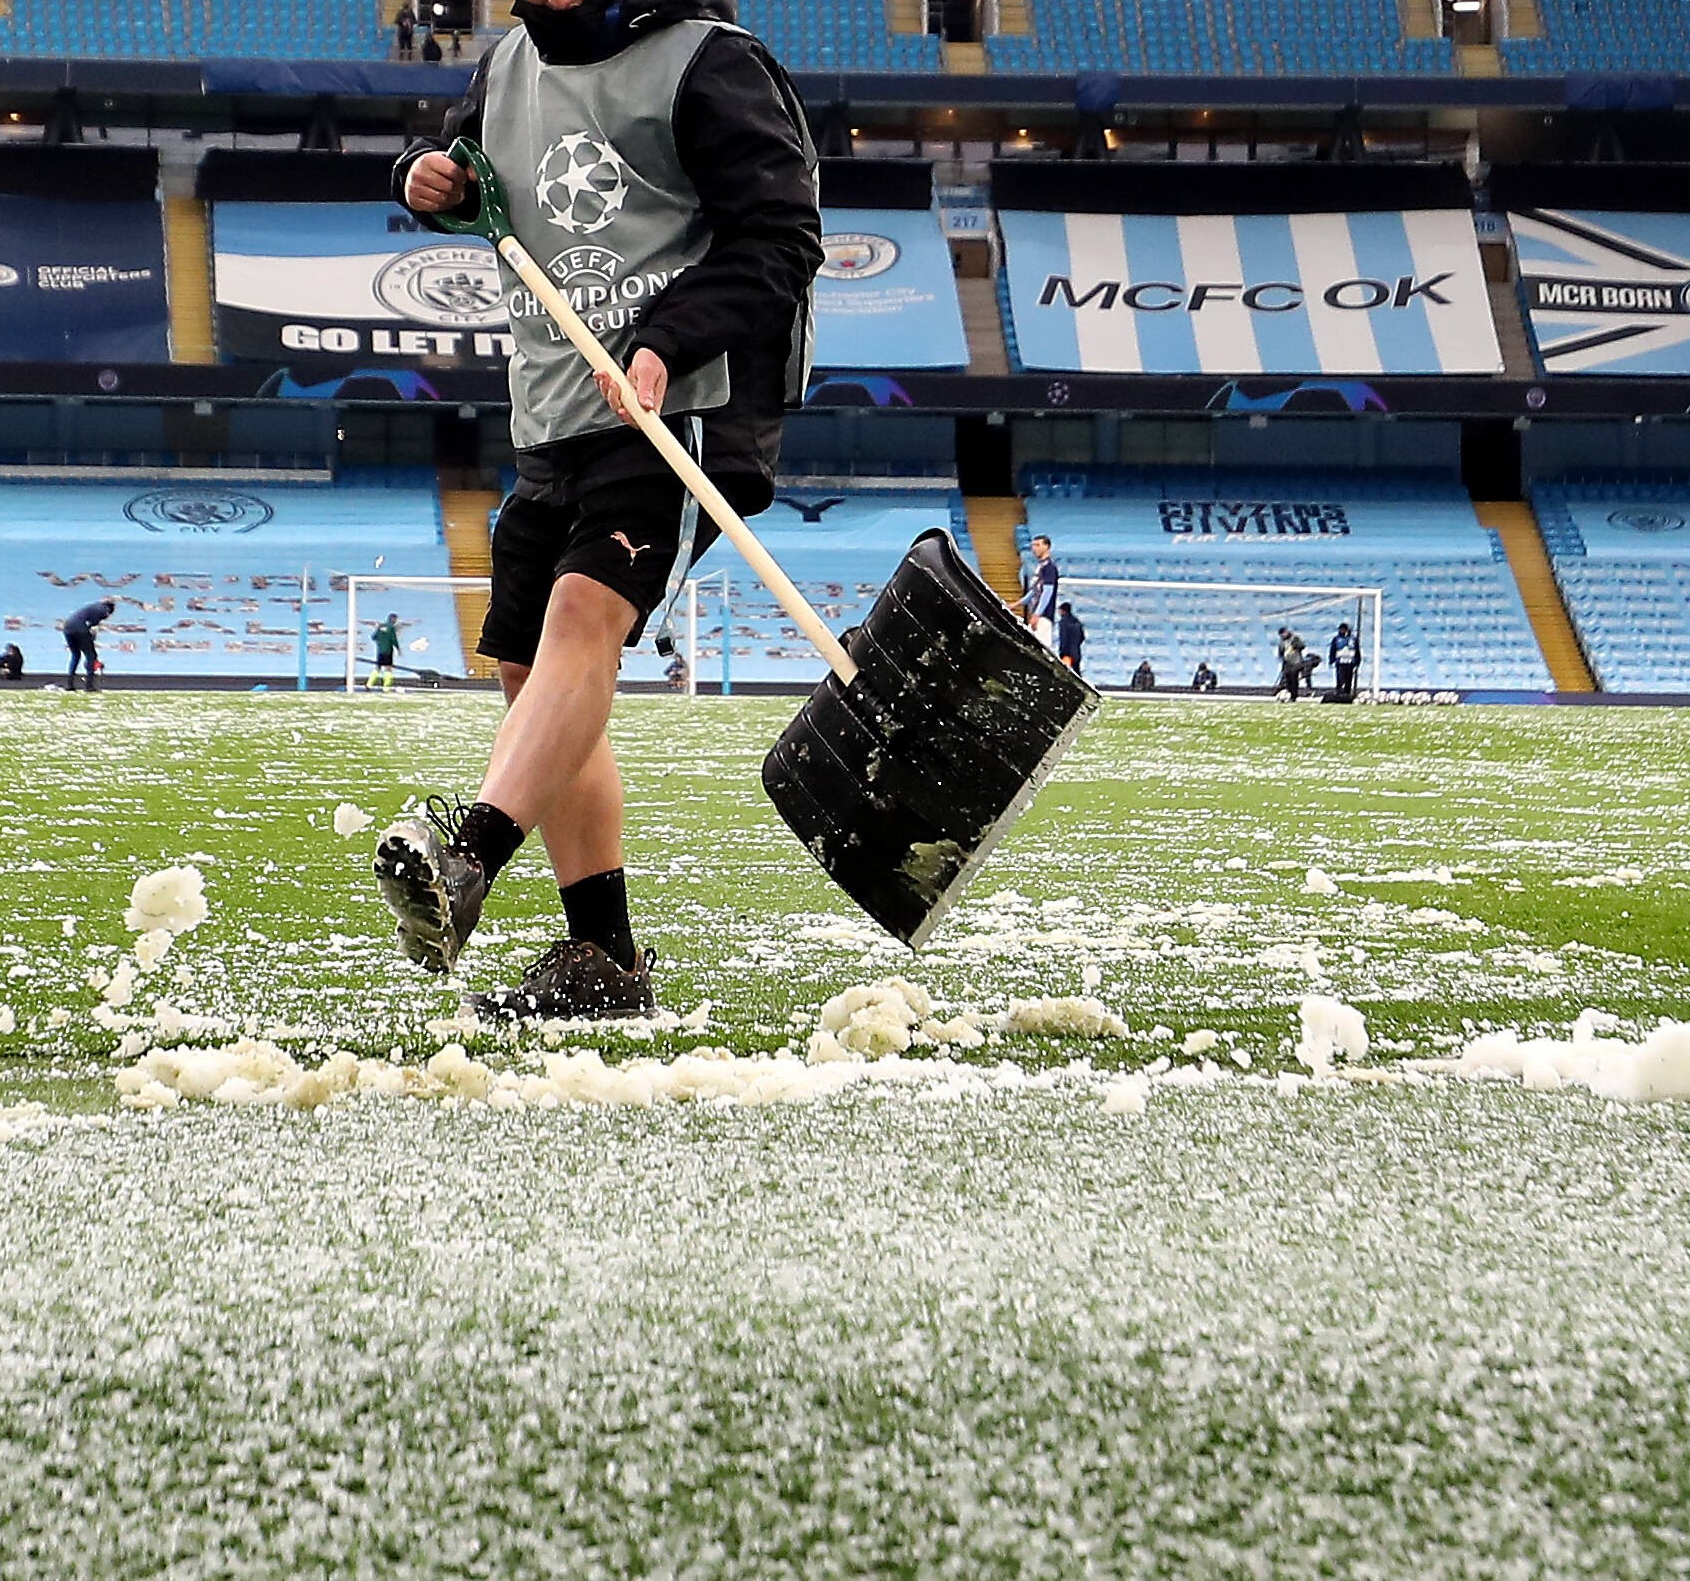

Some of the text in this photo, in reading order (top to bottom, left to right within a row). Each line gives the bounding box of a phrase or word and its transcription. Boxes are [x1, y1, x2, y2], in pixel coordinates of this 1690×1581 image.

[953, 215, 979, 227] 217
[37, 266, 115, 275] OFFICIAL
[38, 269, 151, 282] SUPPORTERS
[552, 251, 619, 278] UEFA
[38, 279, 85, 290] CLUB
[510, 267, 687, 318] CHMPION
[1037, 271, 1457, 312] MCFC OK
[1539, 283, 1673, 309] MCR BORN
[438, 314, 487, 324] CITY
[546, 306, 642, 342] LGUE
[281, 324, 359, 352] GO
[372, 329, 463, 355] LET
[1161, 516, 1351, 534] GIVING
